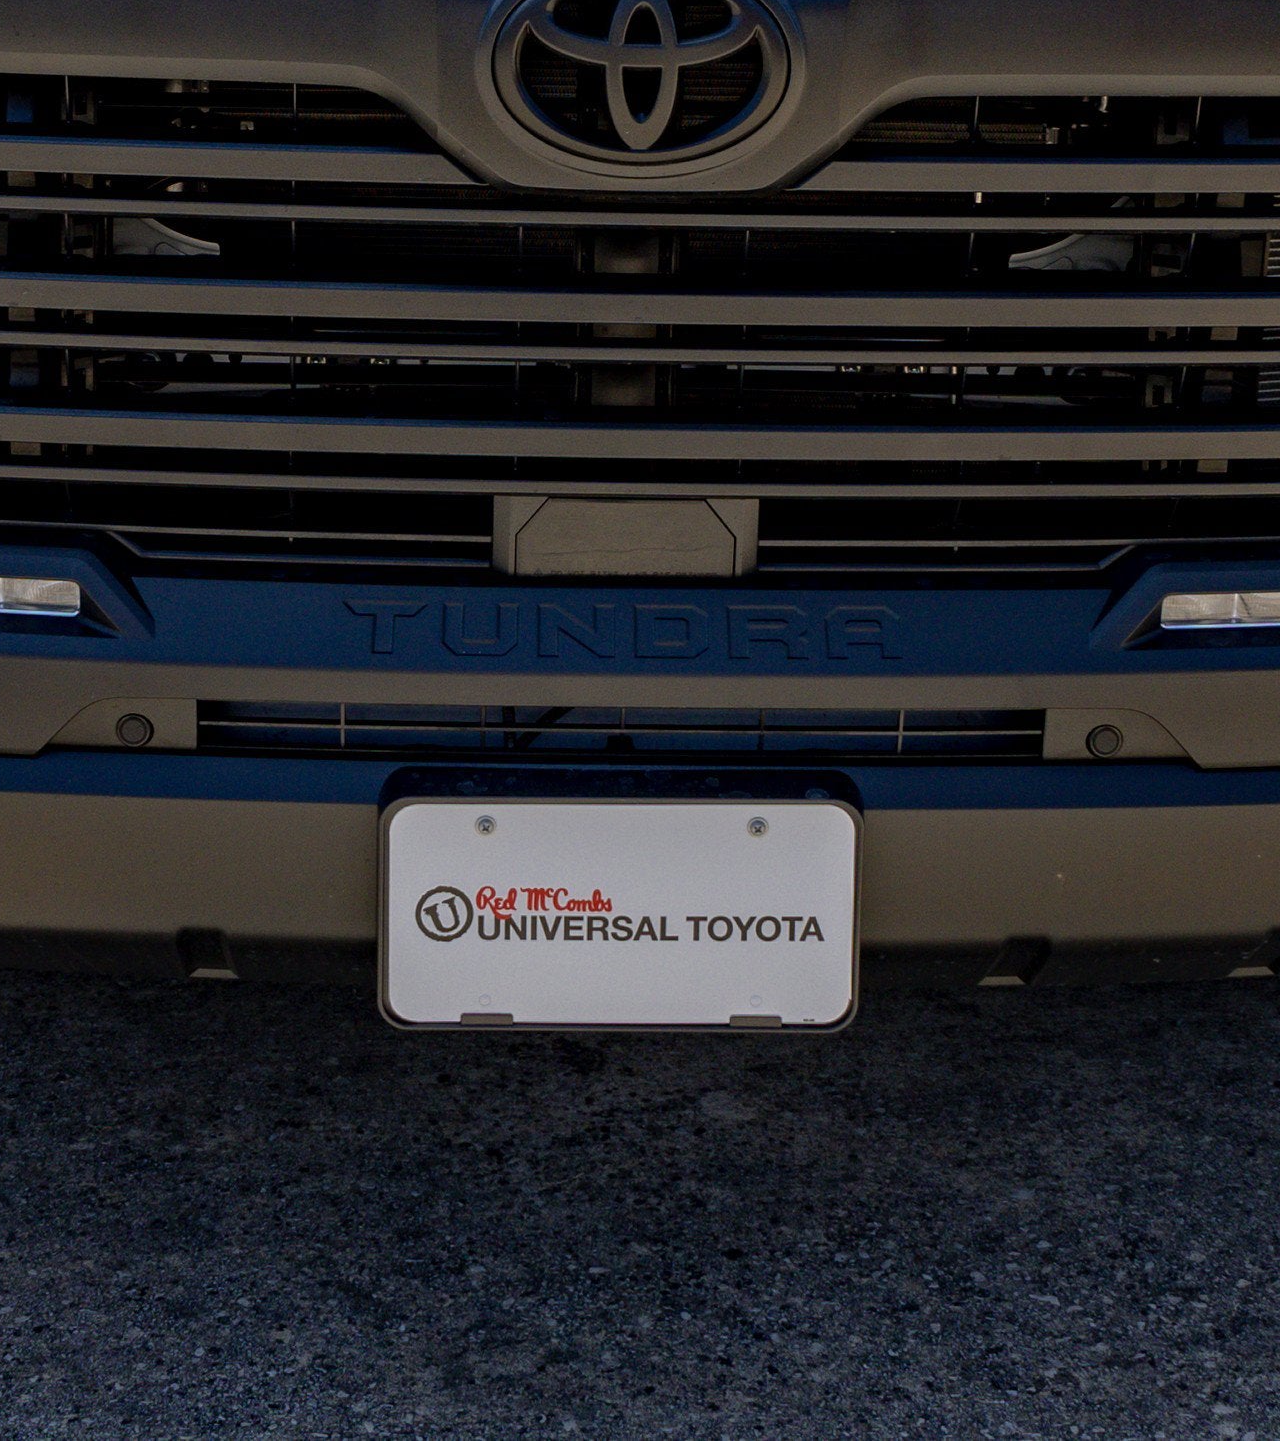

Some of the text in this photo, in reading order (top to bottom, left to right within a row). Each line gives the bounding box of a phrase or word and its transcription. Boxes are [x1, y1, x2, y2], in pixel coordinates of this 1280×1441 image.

[342, 599, 904, 660] TUNDRA
[475, 885, 613, 920] Red McCombs
[477, 914, 825, 943] UNIVERSAL TOYOTA
